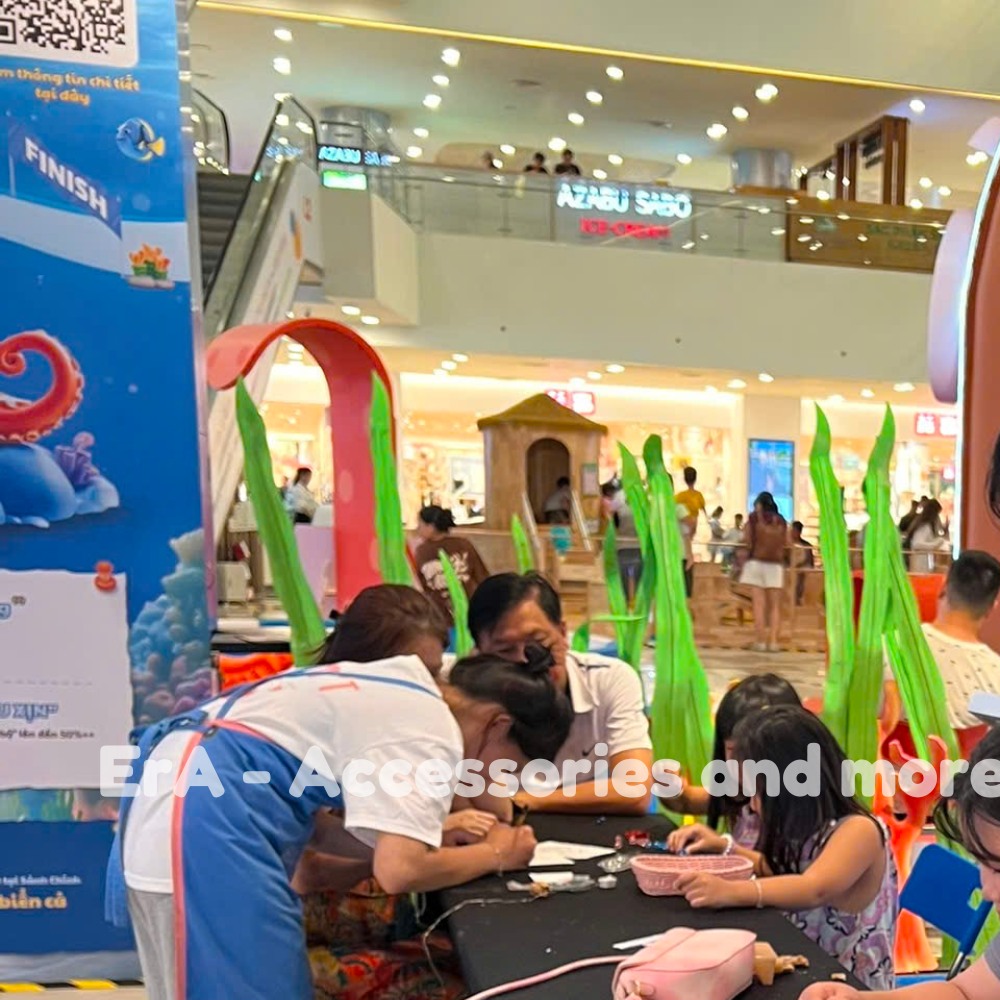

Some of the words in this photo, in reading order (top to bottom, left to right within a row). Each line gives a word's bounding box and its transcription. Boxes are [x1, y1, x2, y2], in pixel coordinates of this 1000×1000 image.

[24, 136, 109, 220] FINISH
[556, 182, 629, 213] AZABU
[634, 189, 692, 219] SABO
